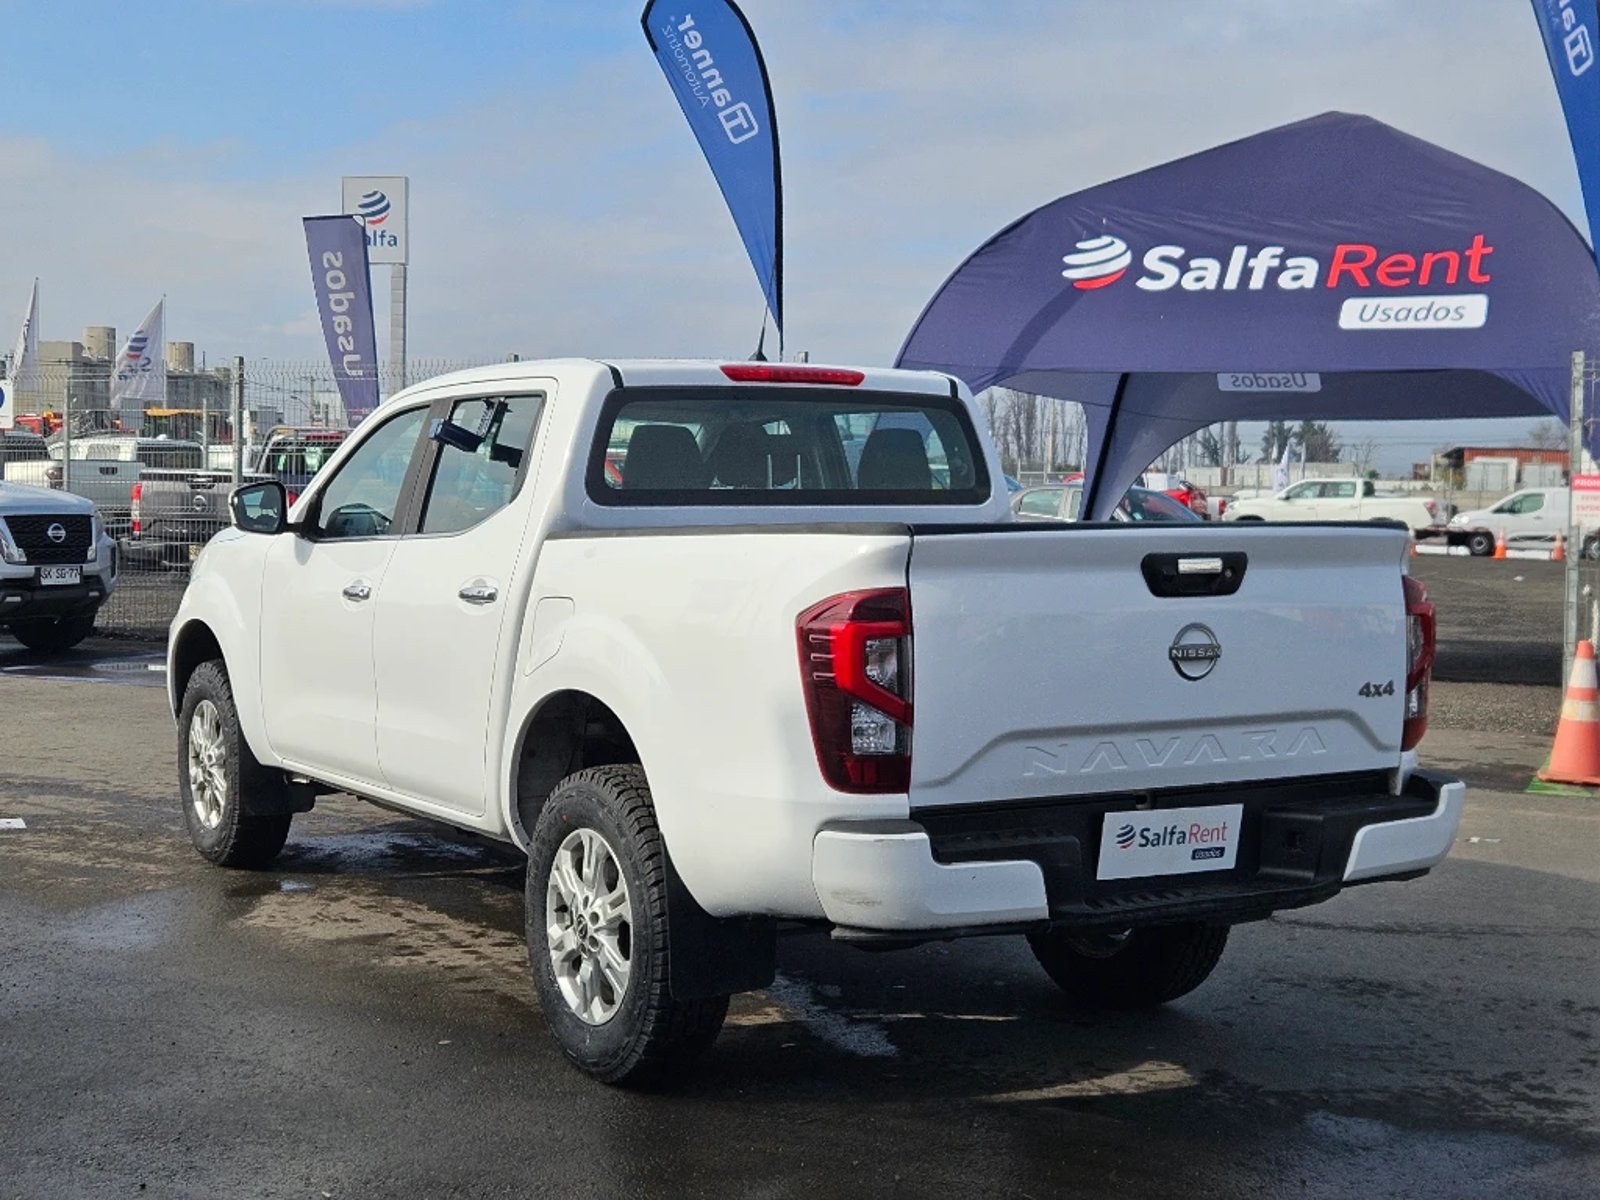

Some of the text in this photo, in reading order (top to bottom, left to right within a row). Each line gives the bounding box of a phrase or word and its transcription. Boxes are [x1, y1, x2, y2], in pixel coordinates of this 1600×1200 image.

[366, 229, 398, 247] alfa
[1359, 301, 1466, 323] Usados
[1358, 680, 1395, 697] 4x4
[1023, 727, 1327, 775] NAVARA
